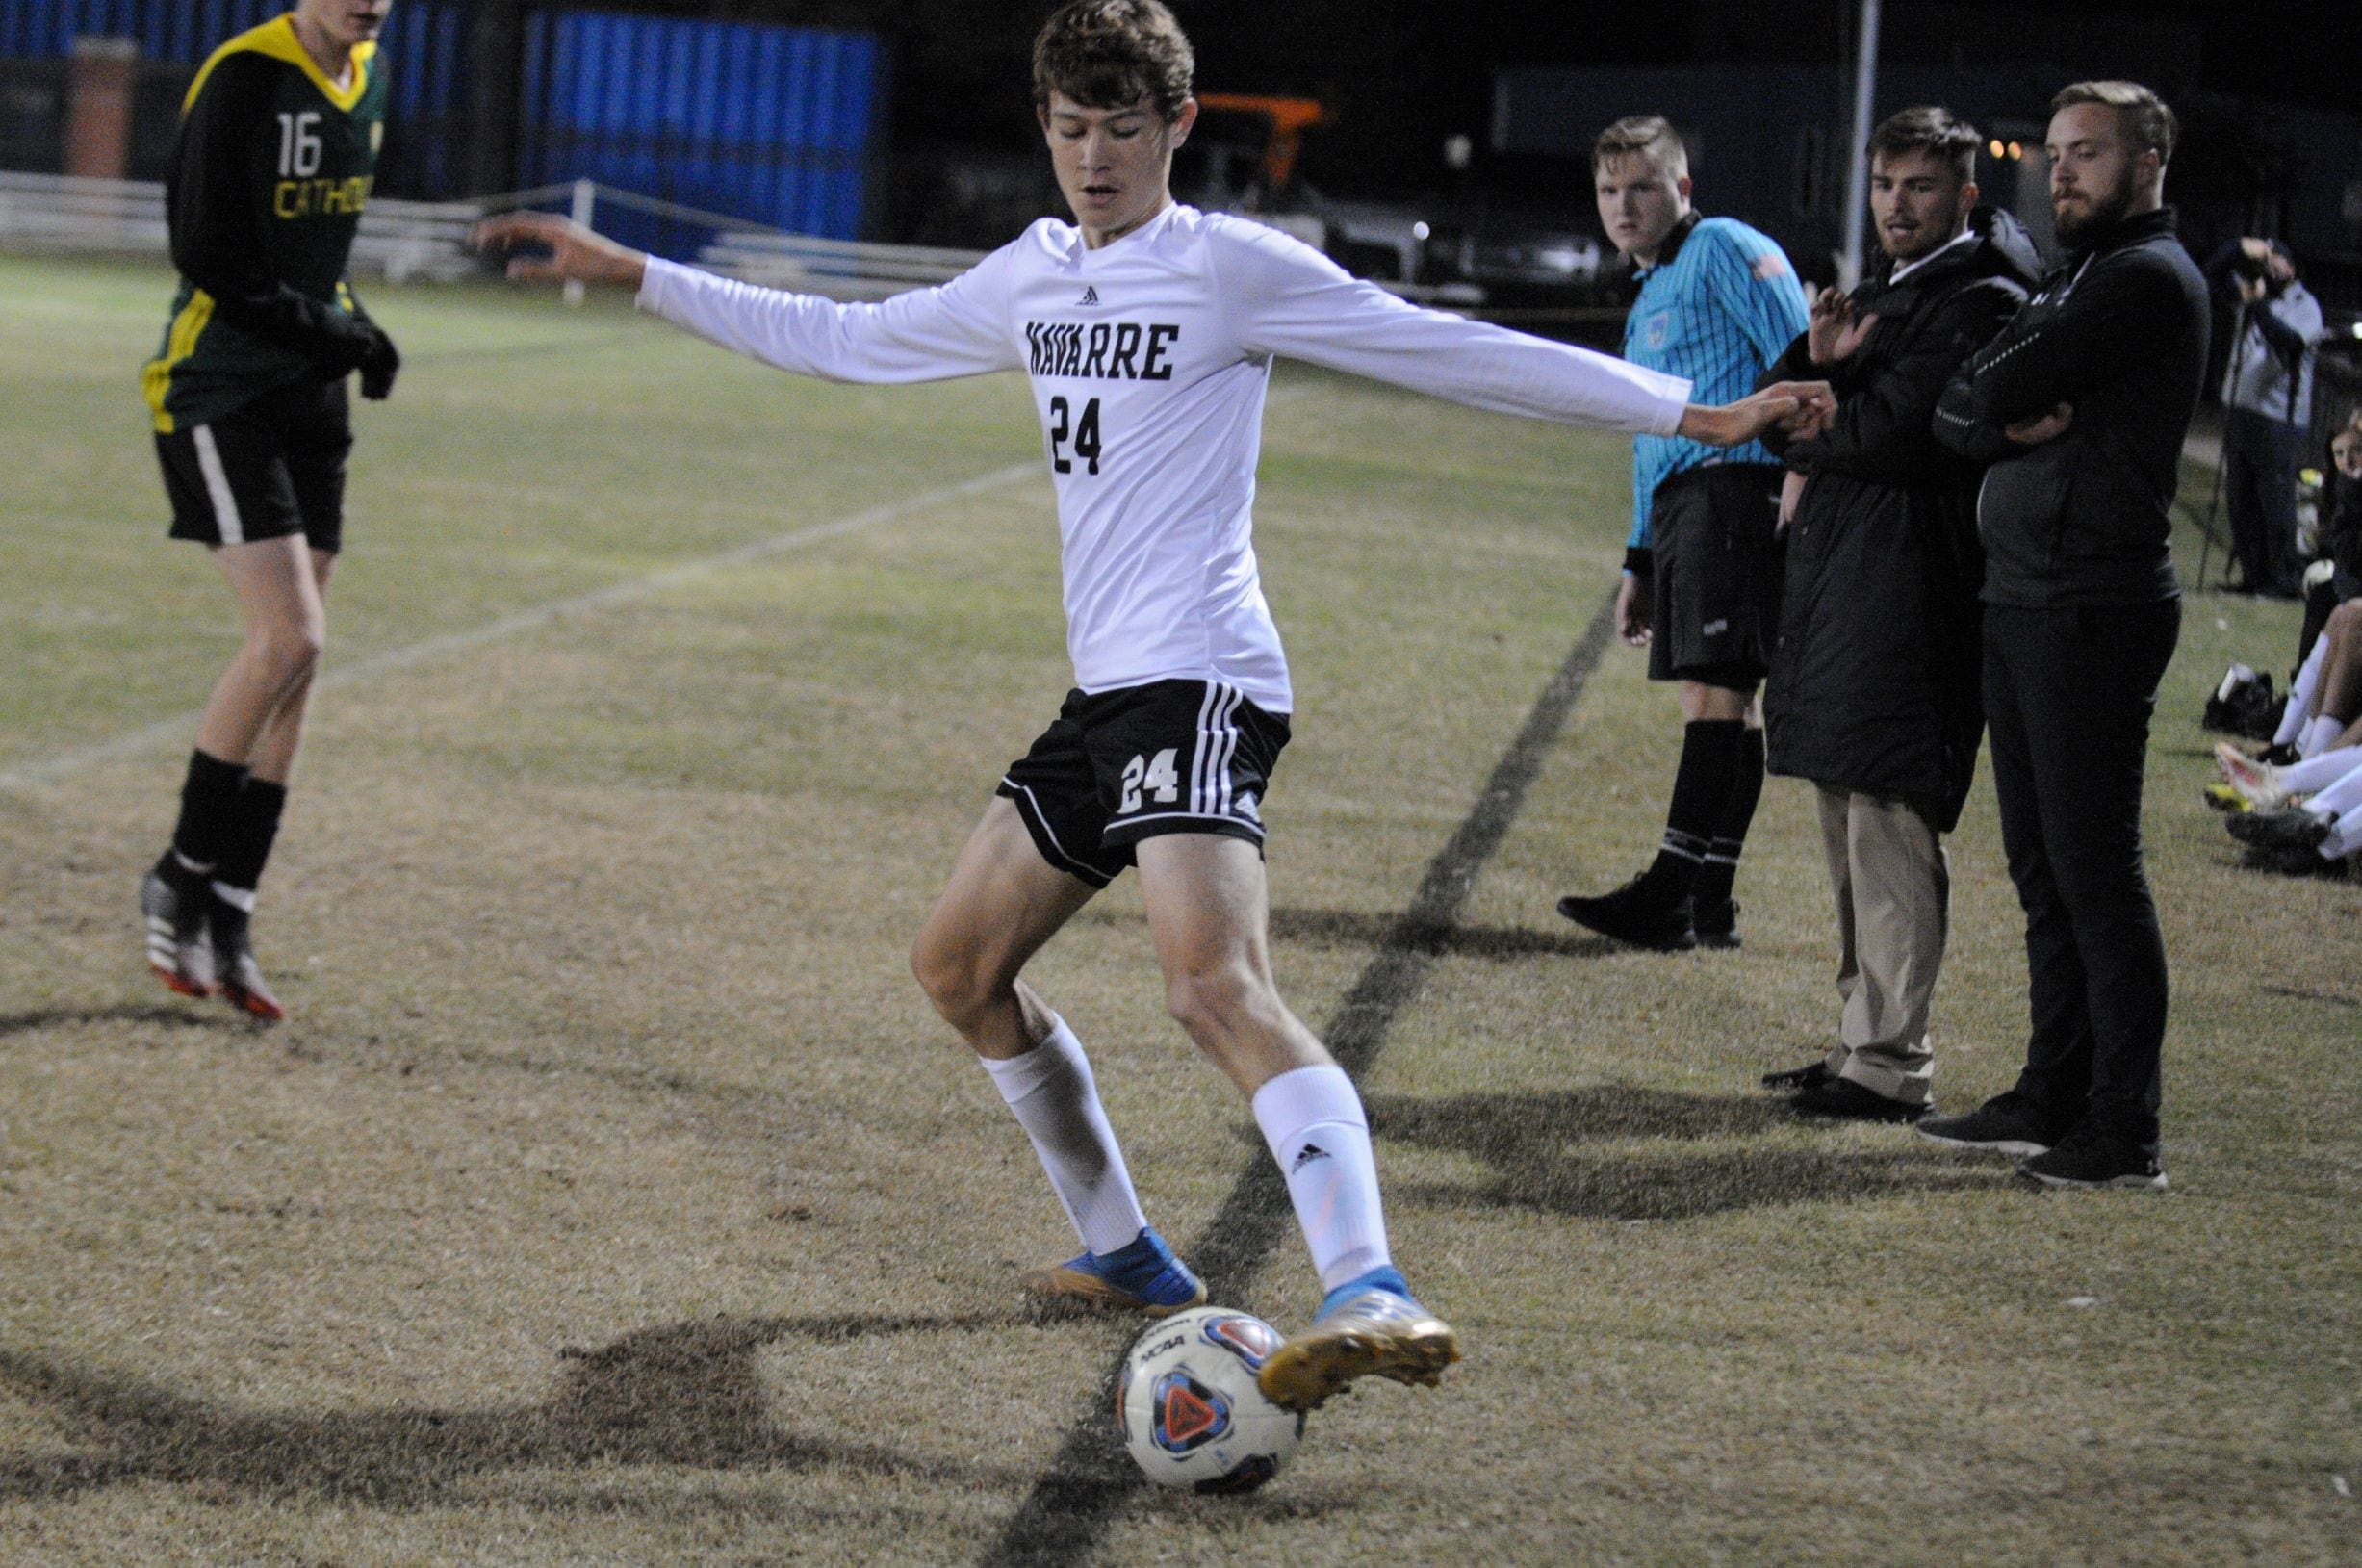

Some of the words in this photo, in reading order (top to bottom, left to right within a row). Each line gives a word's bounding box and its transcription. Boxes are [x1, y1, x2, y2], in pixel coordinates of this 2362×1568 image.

[277, 111, 322, 178] 16
[1026, 321, 1179, 380] NAVARRE
[1050, 396, 1101, 475] 24
[1117, 748, 1178, 815] 24
[1141, 1335, 1185, 1363] NCAA
